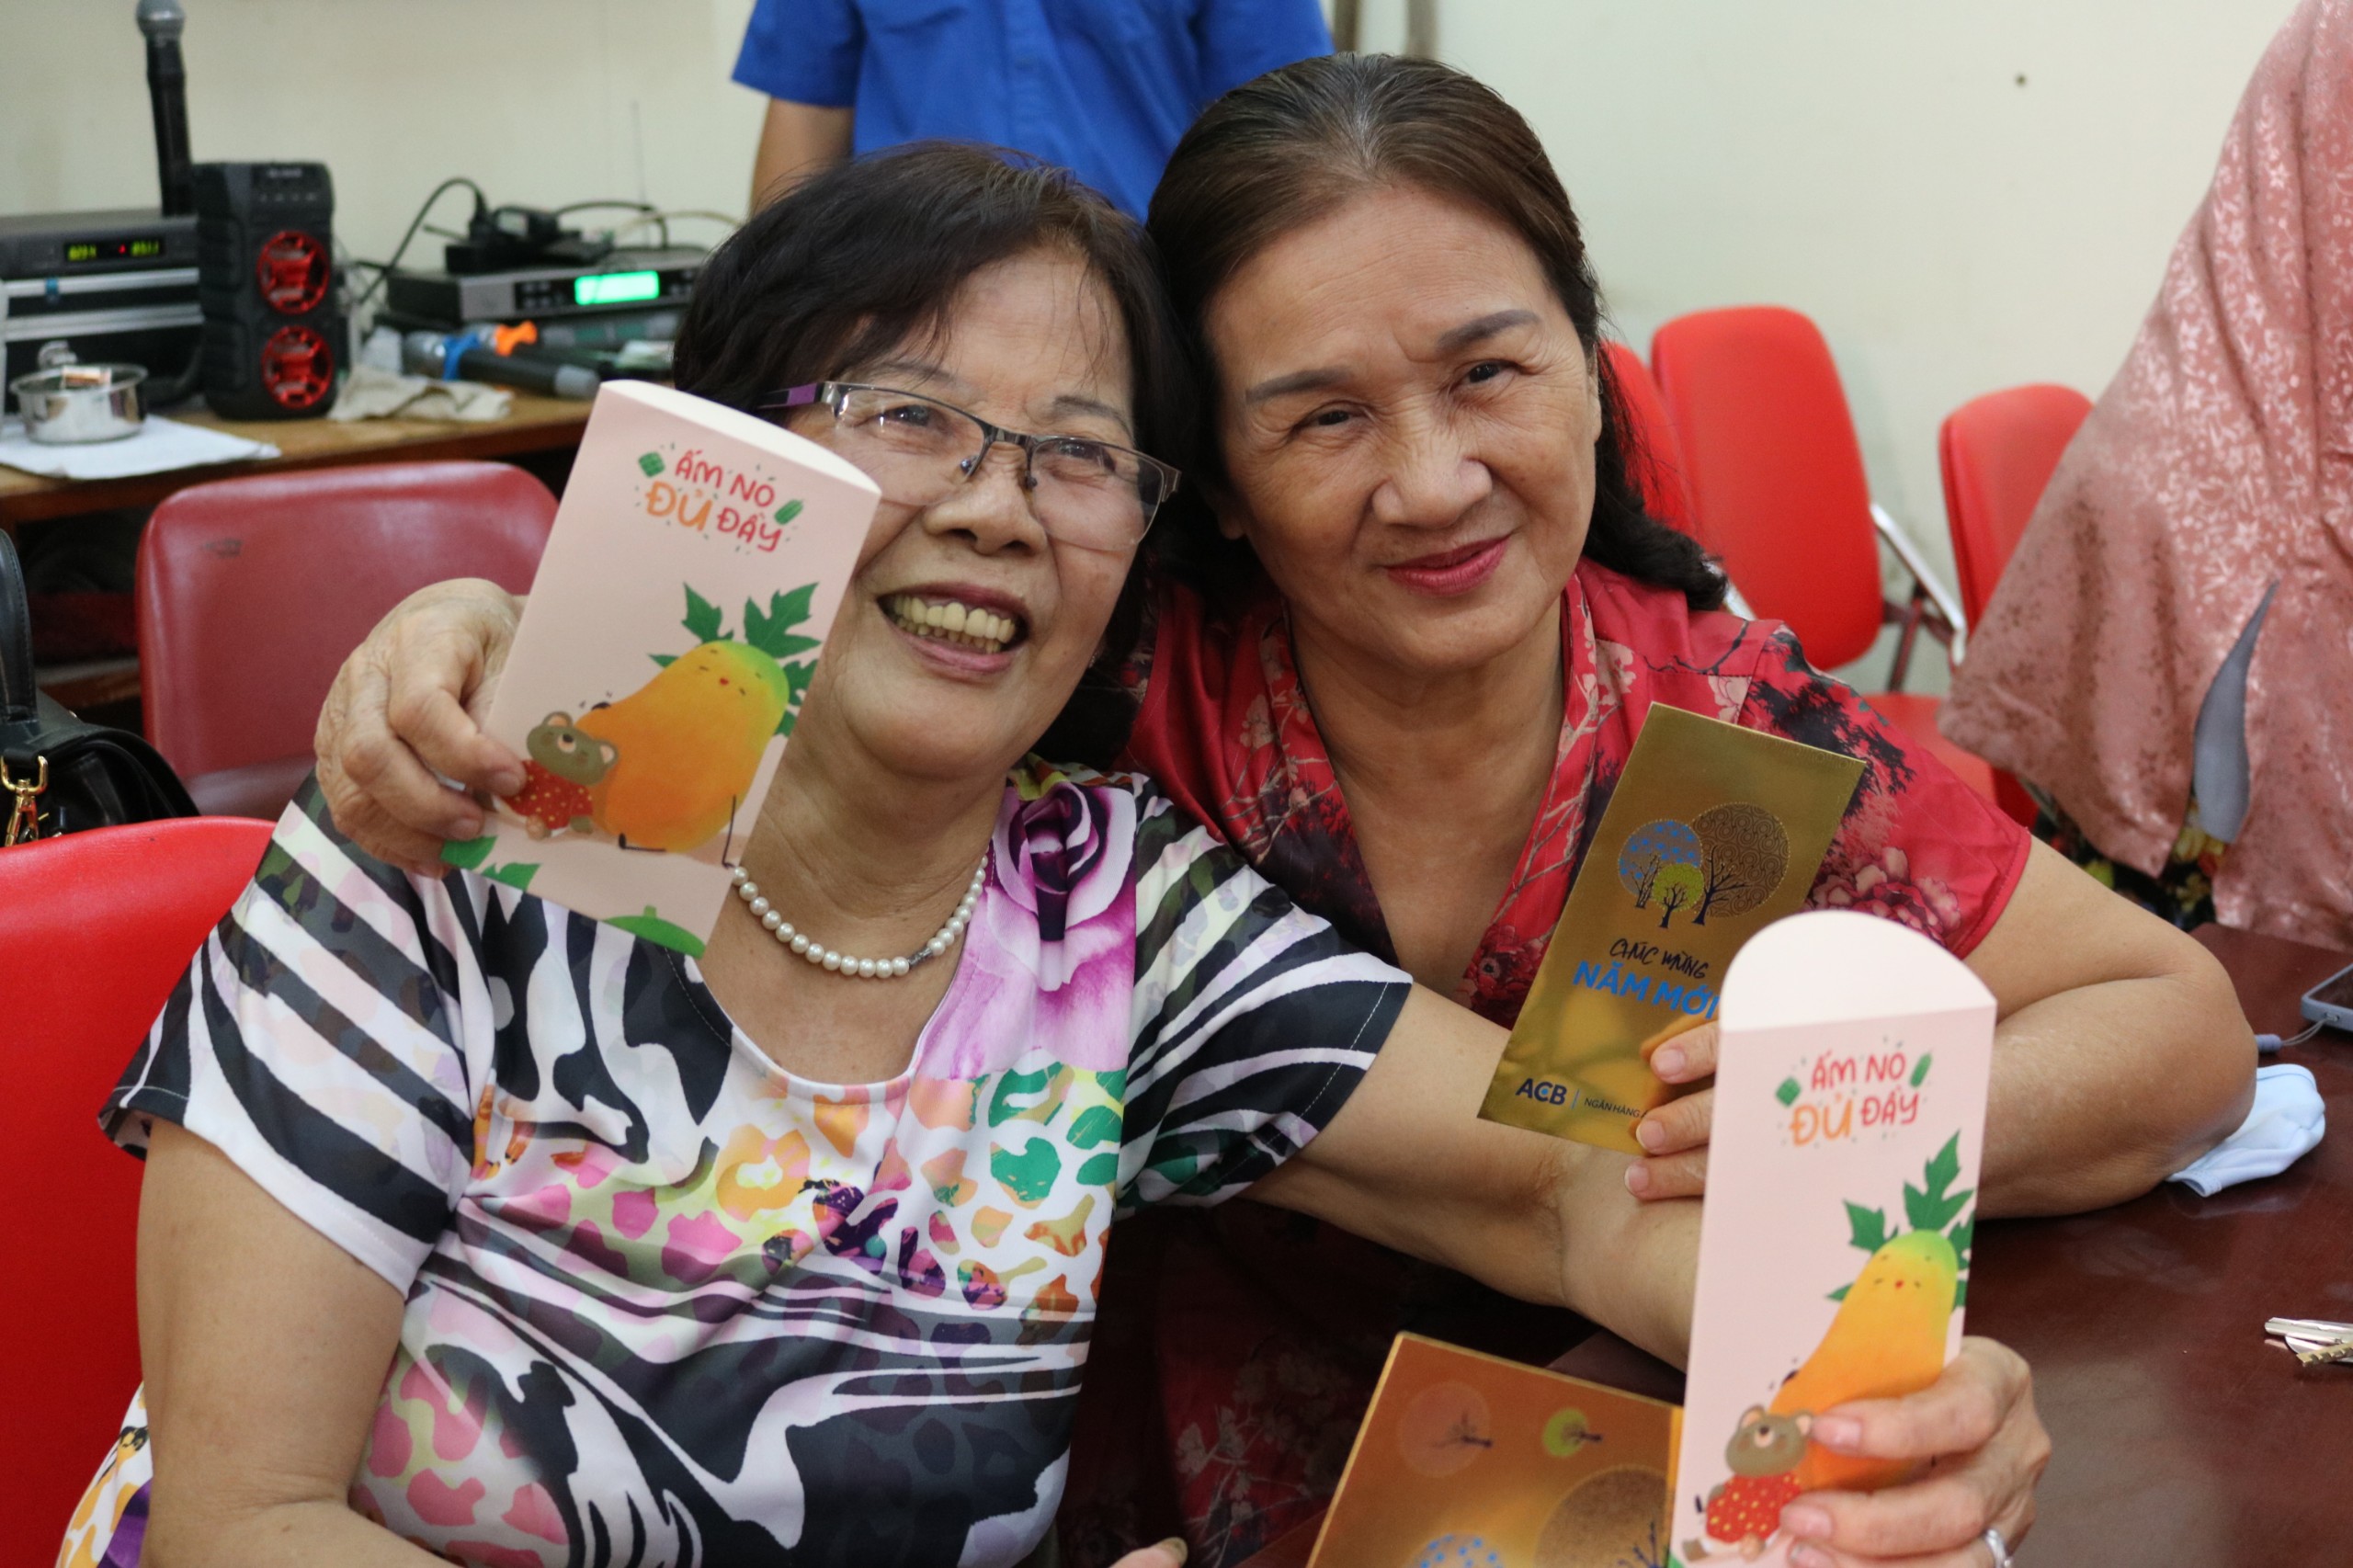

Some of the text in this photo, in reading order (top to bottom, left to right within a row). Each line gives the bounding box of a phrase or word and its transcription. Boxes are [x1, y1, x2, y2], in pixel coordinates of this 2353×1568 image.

[675, 449, 776, 507] ẤM NO
[645, 481, 782, 552] ĐỦ ĐẦY
[1572, 960, 1721, 1020] NĂM MỚI
[1516, 1078, 1567, 1106] ACB
[1584, 1097, 1612, 1111] NGÂN
[1811, 1050, 1906, 1091] ẤM NO
[1789, 1092, 1853, 1146] ĐỦ
